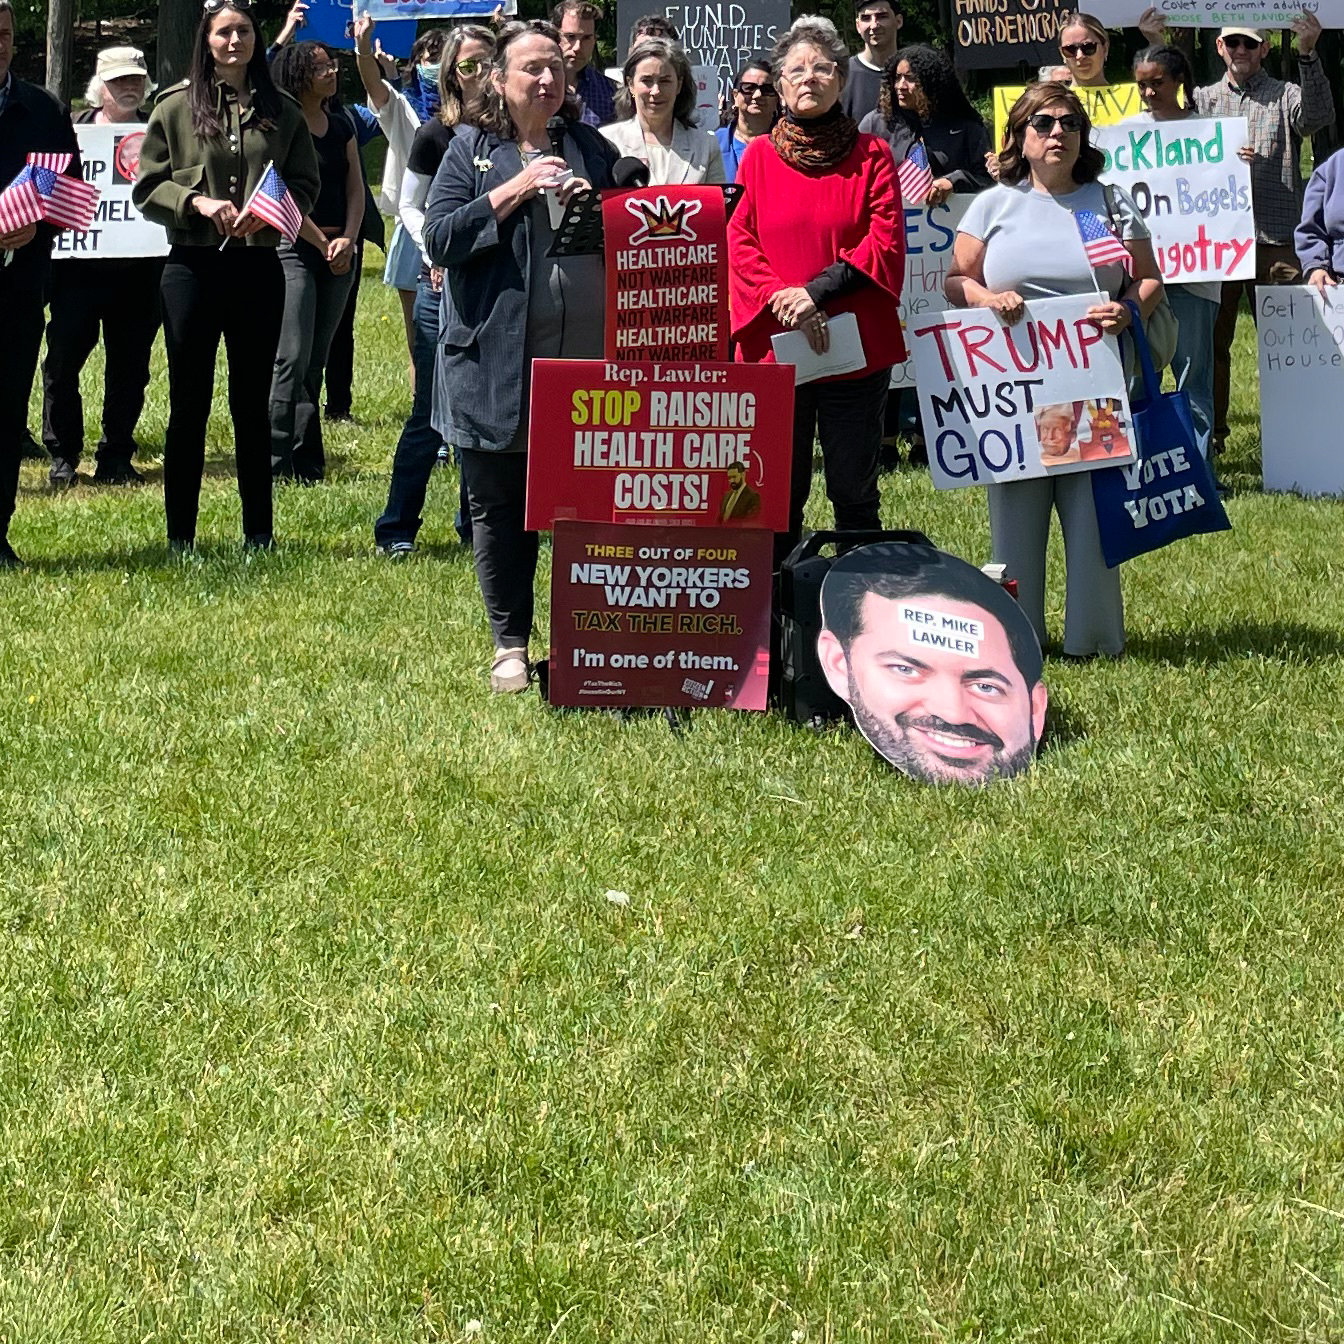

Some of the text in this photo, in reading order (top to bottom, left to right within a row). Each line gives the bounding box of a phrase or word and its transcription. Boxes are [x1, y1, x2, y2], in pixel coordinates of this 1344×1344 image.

[665, 3, 746, 29] FUND
[1205, 1, 1218, 11] or
[1225, 0, 1265, 11] commit
[1212, 12, 1245, 23] BETH
[958, 19, 994, 47] OUR
[1176, 174, 1251, 217] Bagels,
[616, 243, 718, 270] HEALTHCARE
[1157, 224, 1254, 279] igotry
[617, 266, 718, 289] NOT WARFARE
[617, 284, 718, 310] HEALTHCARE
[1261, 295, 1296, 319] Get
[617, 306, 718, 327] NOT WARFARE
[617, 323, 718, 347] HEALTHCARE
[1264, 325, 1295, 347] Out
[1303, 325, 1320, 348] Of
[616, 344, 718, 361] NOT WARFARE
[914, 318, 1104, 382] TRUMP
[603, 364, 727, 386] Rep. Lawler:
[571, 389, 755, 427] STOP RAISING
[931, 379, 1044, 428] MUST
[574, 431, 750, 468] HEALTH CARE
[935, 424, 1026, 482] GO!
[1120, 446, 1190, 491] VOTE
[614, 474, 709, 510] COSTS!
[1124, 484, 1205, 529] VOTA
[585, 544, 737, 560] THREE OUT OF FOUR
[571, 563, 750, 588] NEW YORKERS
[605, 586, 720, 608] WANT TO
[572, 610, 743, 635] TAX THE RICH.
[904, 609, 978, 636] REP. MIKE
[913, 629, 974, 654] LAWLER
[573, 649, 739, 670] I'm one of them.
